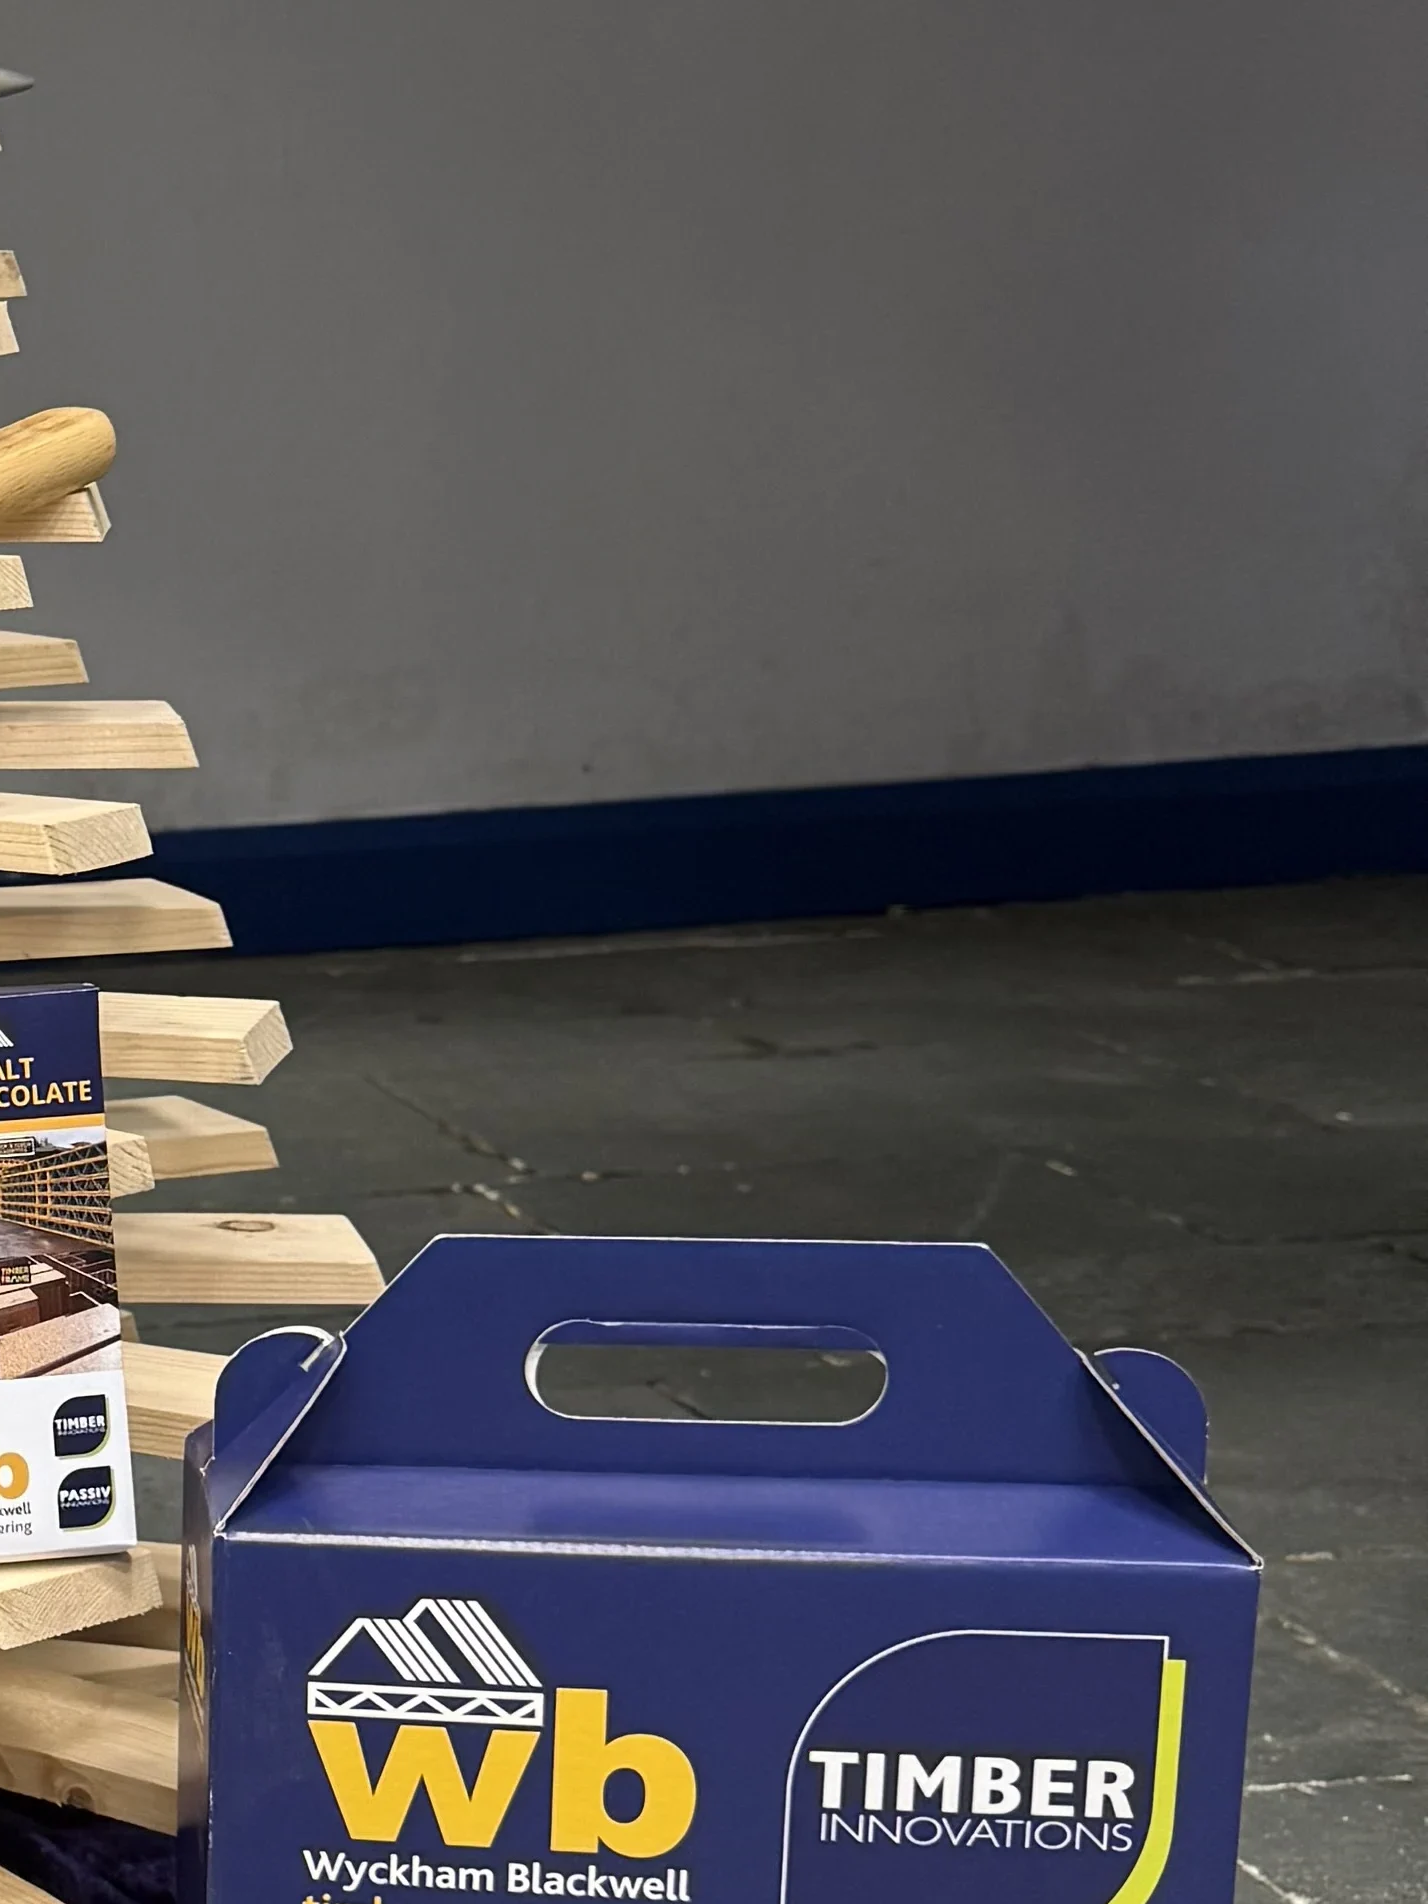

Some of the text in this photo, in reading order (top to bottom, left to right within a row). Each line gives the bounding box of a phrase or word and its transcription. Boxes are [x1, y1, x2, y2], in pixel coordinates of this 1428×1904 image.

[54, 1415, 106, 1431] TIMBER
[59, 1486, 112, 1501] PASSIV
[308, 1688, 697, 1860] wb
[808, 1749, 1137, 1821] TIMBER
[818, 1811, 1134, 1853] INNOVATIONS
[302, 1849, 690, 1903] Wyckham Blackwell
